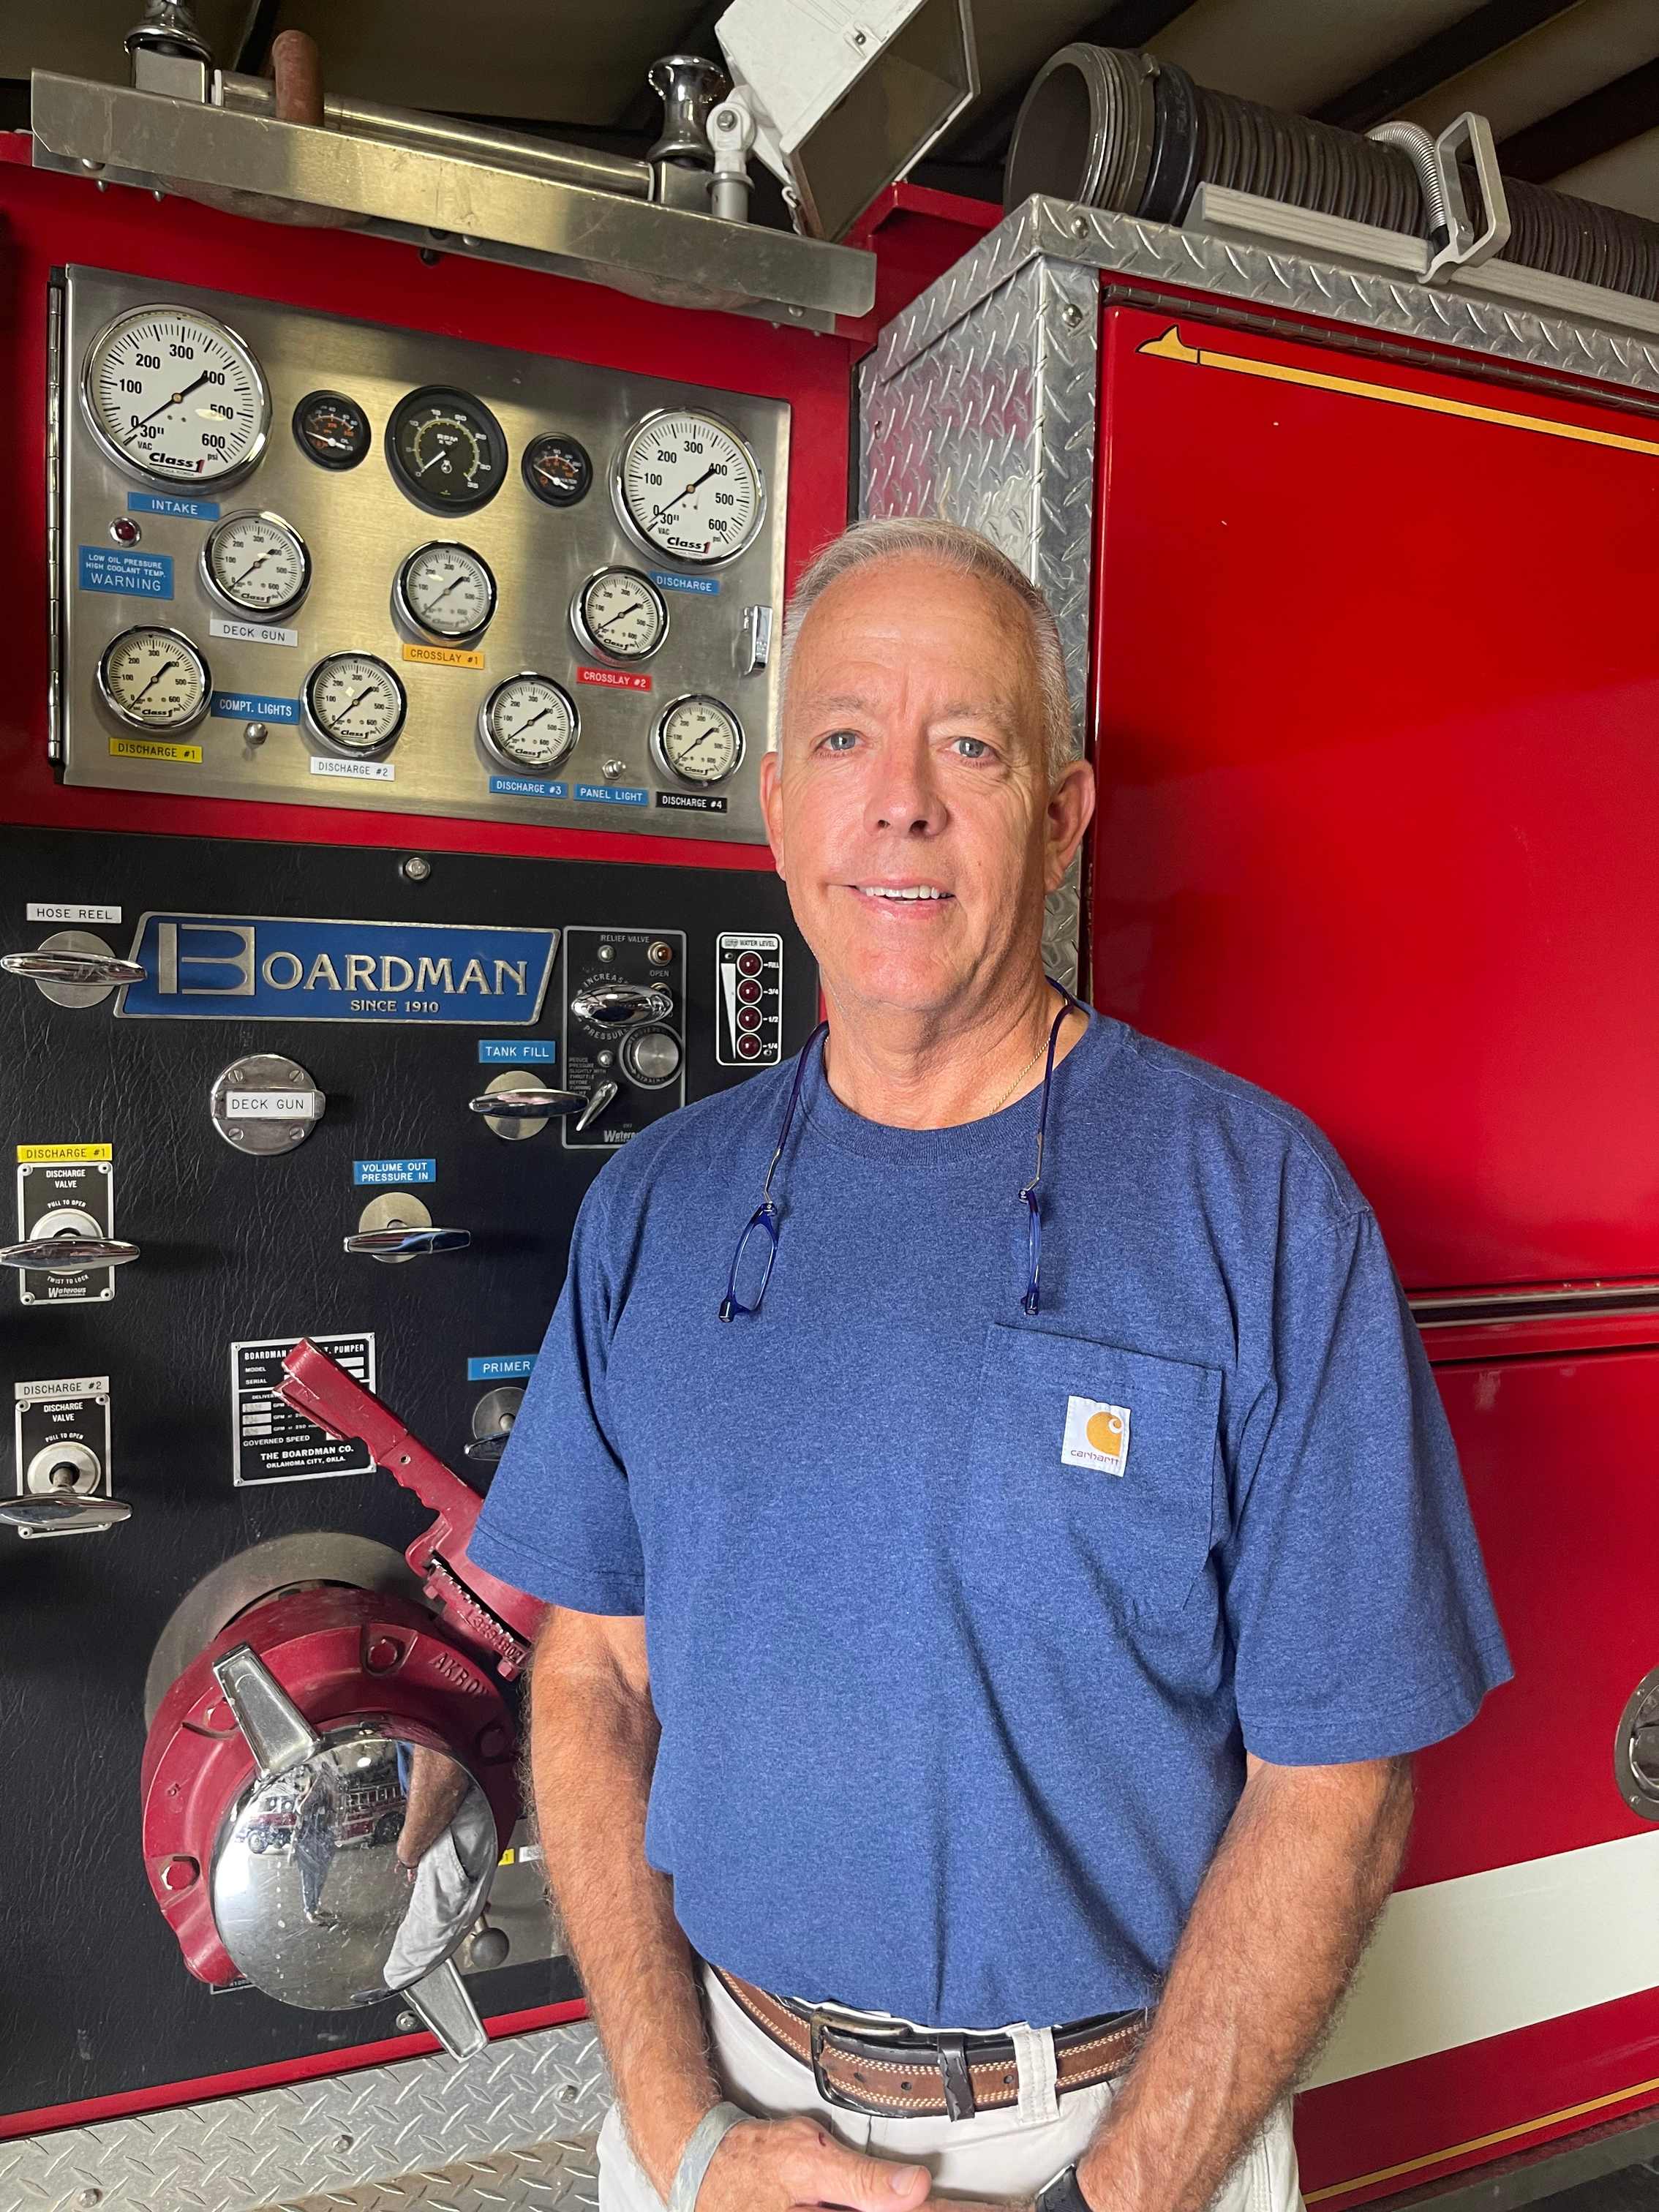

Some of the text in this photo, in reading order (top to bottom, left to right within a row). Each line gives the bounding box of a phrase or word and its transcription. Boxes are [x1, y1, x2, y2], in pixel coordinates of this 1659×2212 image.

[170, 344, 194, 359] 300
[136, 353, 160, 369] 200
[119, 379, 142, 394] 100
[138, 441, 152, 450] VAC
[202, 433, 225, 449] 600
[684, 440, 703, 454] 300
[207, 453, 218, 461] psi
[658, 450, 677, 463] 200
[644, 472, 662, 486] 100
[715, 492, 734, 505] 500
[151, 500, 198, 515] INTAKE
[658, 527, 670, 535] VAC
[709, 519, 727, 532] 600
[86, 562, 165, 578] HIGH COOLANT TEMP.
[124, 558, 162, 569] PRESSURE
[91, 572, 161, 591] WARNING
[656, 576, 712, 592] DISCHARGE
[223, 625, 285, 642] DECK GUN
[410, 649, 478, 665] CROSSLAY #1
[584, 671, 646, 688] CROSSLAY #2
[220, 699, 292, 717] COMPT. LIGHTS
[118, 743, 195, 759] DISCHARGE #1
[319, 762, 388, 776] DISCHARGE #2
[497, 780, 562, 795] DISCHARGE #3
[580, 788, 643, 802] PANEL LIGHT
[662, 796, 722, 809] DISCHARGE #4
[37, 908, 113, 920] HOSE REEL
[159, 923, 527, 996] BOARDMAN
[350, 1000, 439, 1013] SINCE 1910
[486, 1046, 549, 1057] TANK FILL
[232, 1099, 304, 1109] DECK GUN
[26, 1148, 106, 1158] DISCHARGE #1
[363, 1162, 427, 1172] VOLUME OUT
[46, 1170, 86, 1178] DISCHARGE
[362, 1172, 429, 1182] PRESSURE IN
[48, 1200, 61, 1208] PULL
[47, 1275, 64, 1284] TWIST
[75, 1274, 89, 1283] LOCK
[48, 1286, 86, 1298] Waterous
[245, 1350, 287, 1361] BOARDMAN
[334, 1344, 364, 1354] PUMPER
[484, 1361, 530, 1373] PRIMER
[24, 1381, 102, 1395] DISCHARGE #2
[44, 1402, 83, 1412] DISCHARGE
[53, 1414, 75, 1422] VALVE
[45, 1434, 59, 1442] PULL
[243, 1438, 284, 1447] GOVERNED
[260, 1453, 279, 1461] THE
[282, 1447, 336, 1459] BOARDMAN
[1070, 1450, 1119, 1465] carhartt
[266, 1460, 305, 1468] OKLAHOMA
